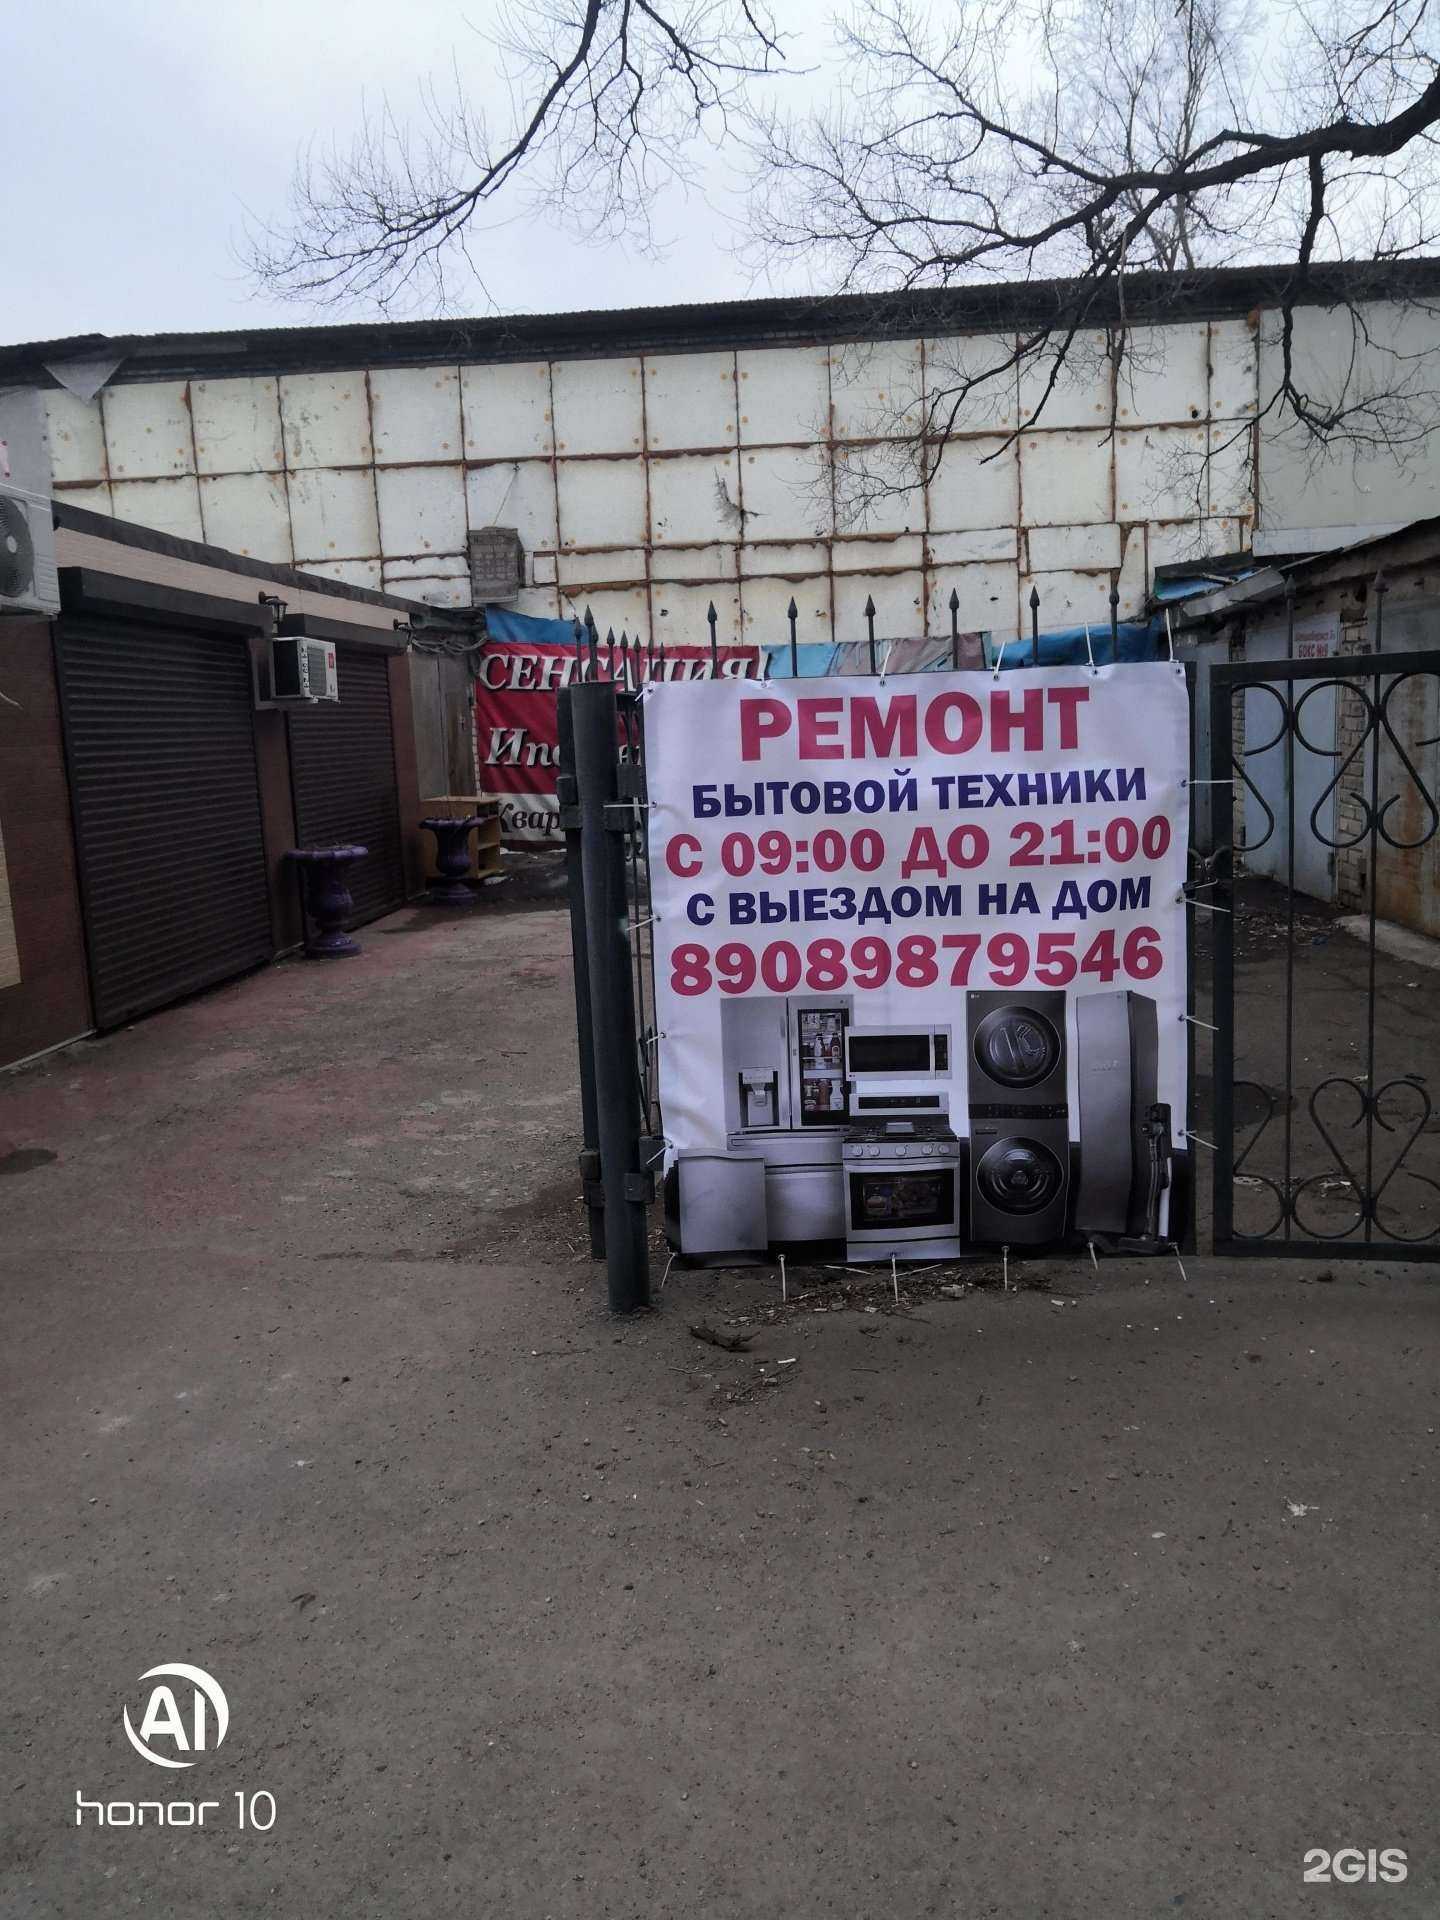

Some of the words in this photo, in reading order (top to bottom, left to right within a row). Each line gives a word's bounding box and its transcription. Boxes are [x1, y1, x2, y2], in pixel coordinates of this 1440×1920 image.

[741, 687, 1090, 761] РЕМОНТ
[692, 768, 918, 819] БЫТОВОЙ
[931, 767, 1147, 810] ТЕХНИКИ
[666, 834, 702, 878] С
[721, 828, 885, 876] 09:00
[902, 824, 989, 878] ДО
[1010, 815, 1170, 867] 21:00
[686, 893, 715, 926] С
[729, 884, 962, 926] ВЫЕЗДОМ
[978, 882, 1041, 916] НА
[1051, 875, 1152, 921] ДОМ
[670, 926, 1163, 996] 89089879546
